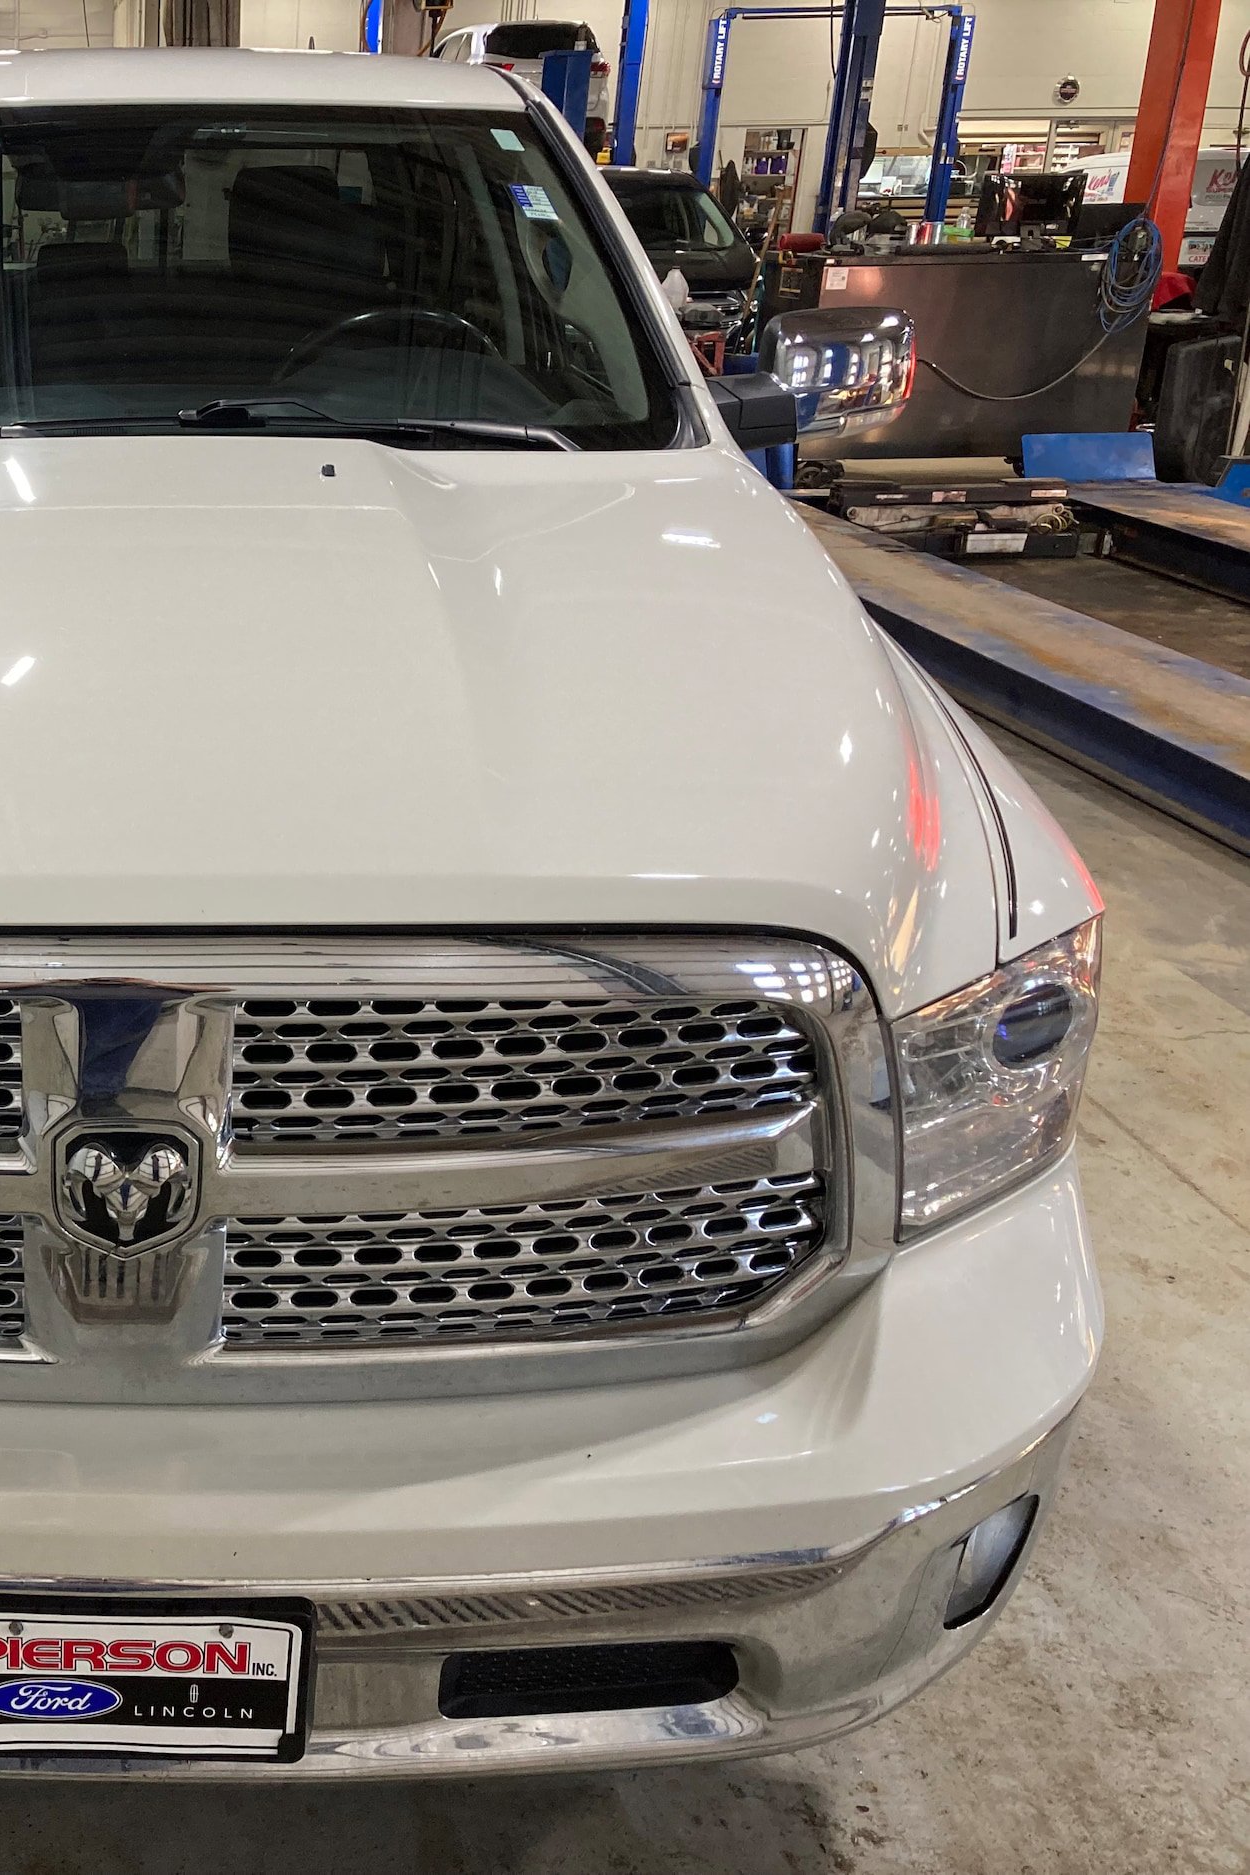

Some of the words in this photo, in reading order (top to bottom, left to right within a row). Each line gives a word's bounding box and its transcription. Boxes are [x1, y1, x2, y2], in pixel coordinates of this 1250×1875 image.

[718, 19, 727, 40] LIFT
[962, 16, 973, 37] LIFT
[713, 41, 725, 80] ROTARY
[956, 38, 969, 76] ROTARY
[252, 1661, 278, 1677] INC.
[9, 1683, 93, 1713] Ford
[134, 1704, 254, 1720] LINCOLN
